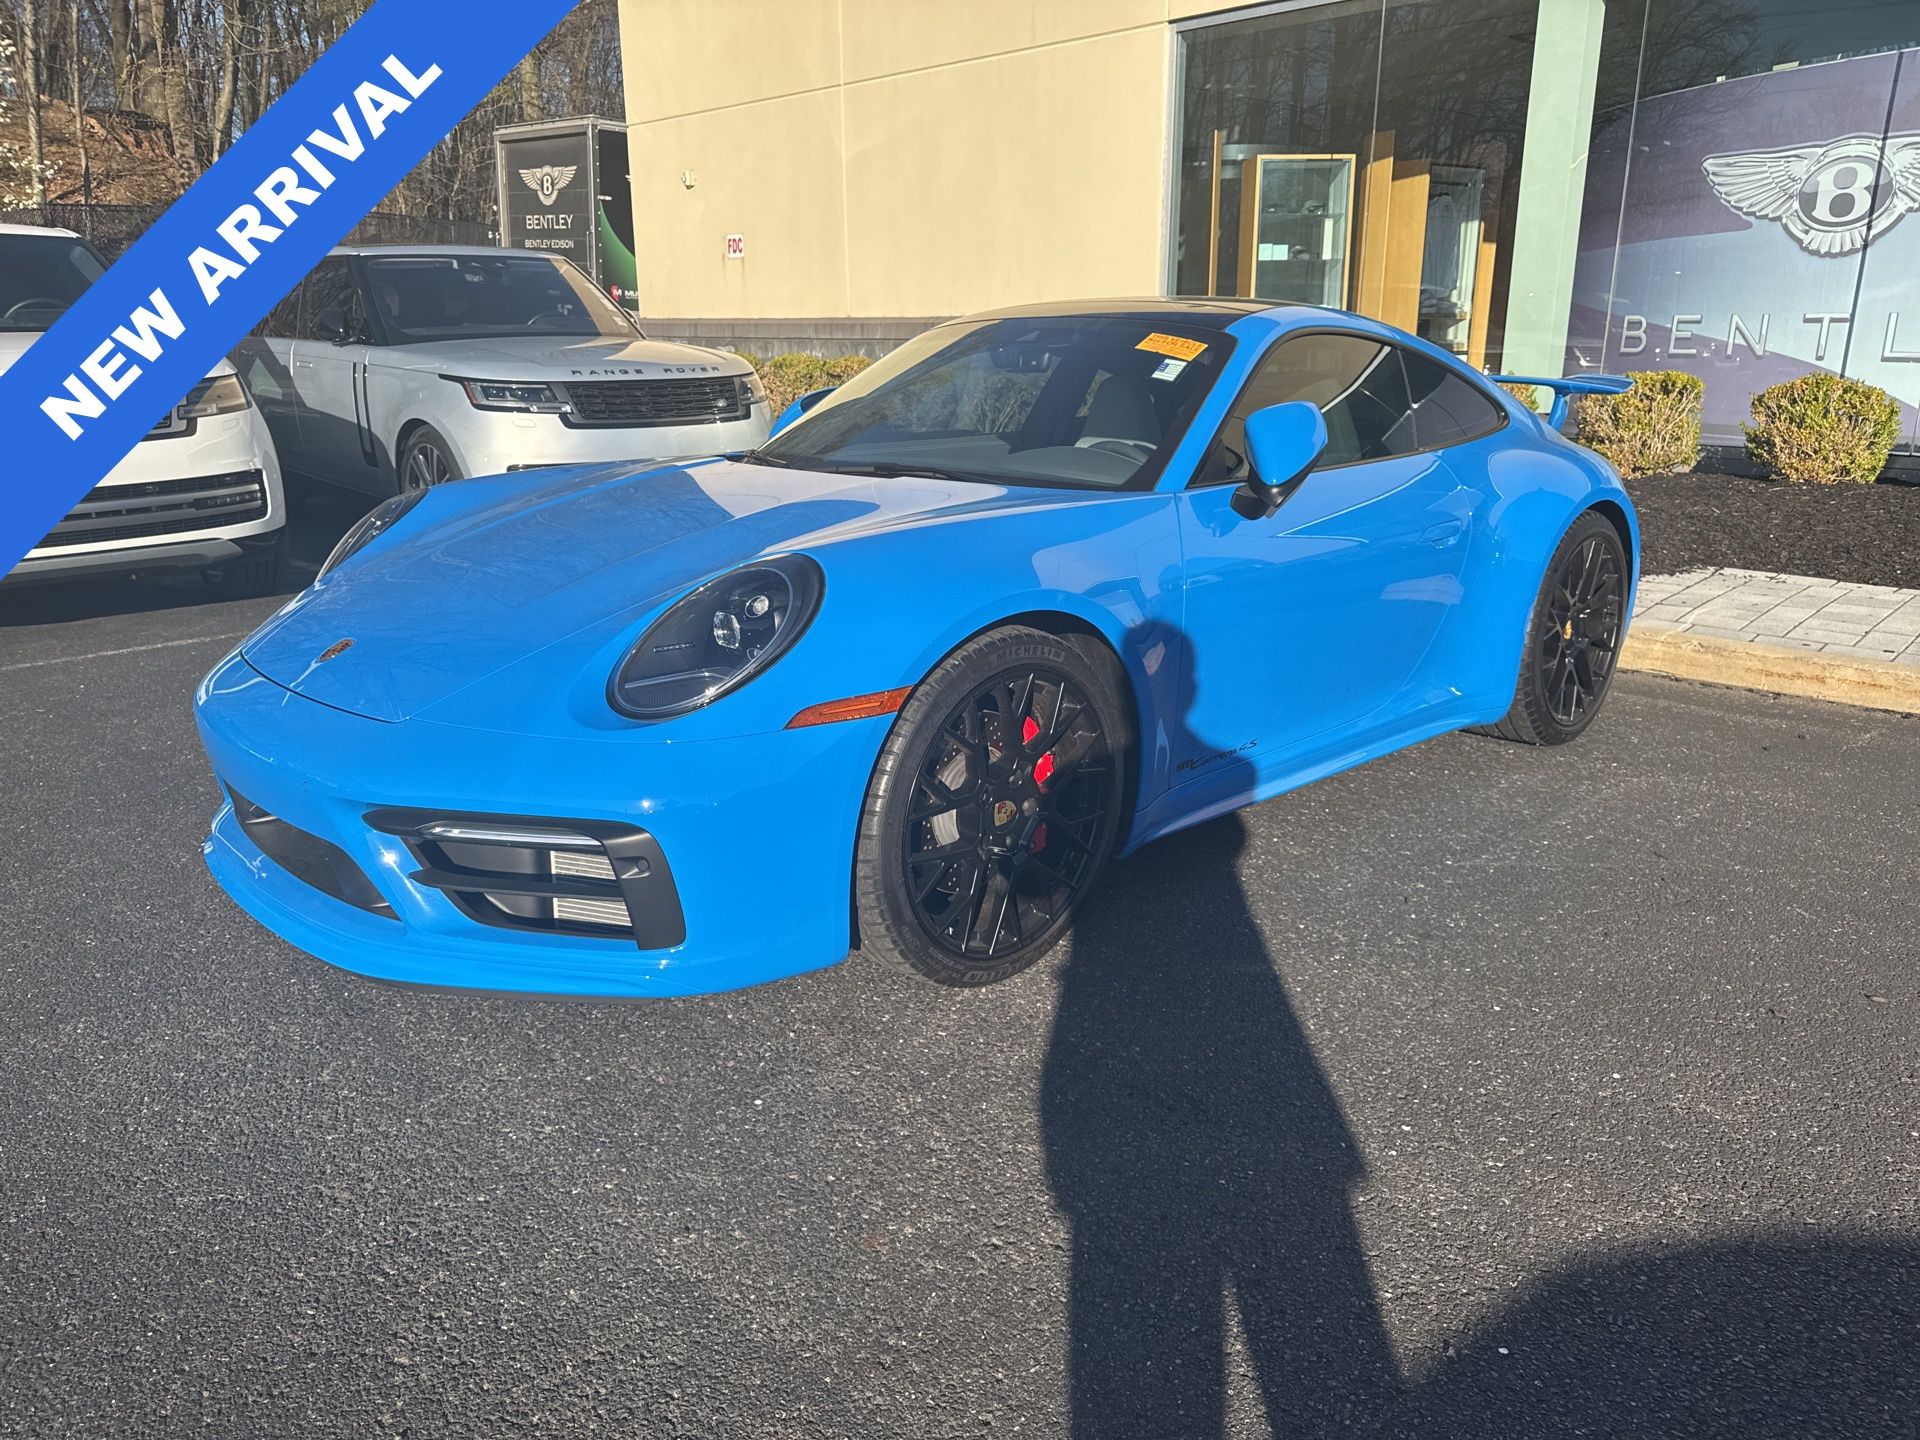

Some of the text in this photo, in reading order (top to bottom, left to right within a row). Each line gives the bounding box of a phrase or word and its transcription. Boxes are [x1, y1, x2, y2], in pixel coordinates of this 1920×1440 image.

[525, 214, 574, 229] BENTLEY
[524, 239, 574, 249] BENTLEY EDISON
[727, 237, 743, 254] FDC
[1619, 312, 1920, 362] BENTL
[571, 366, 720, 376] RANGE ROVER
